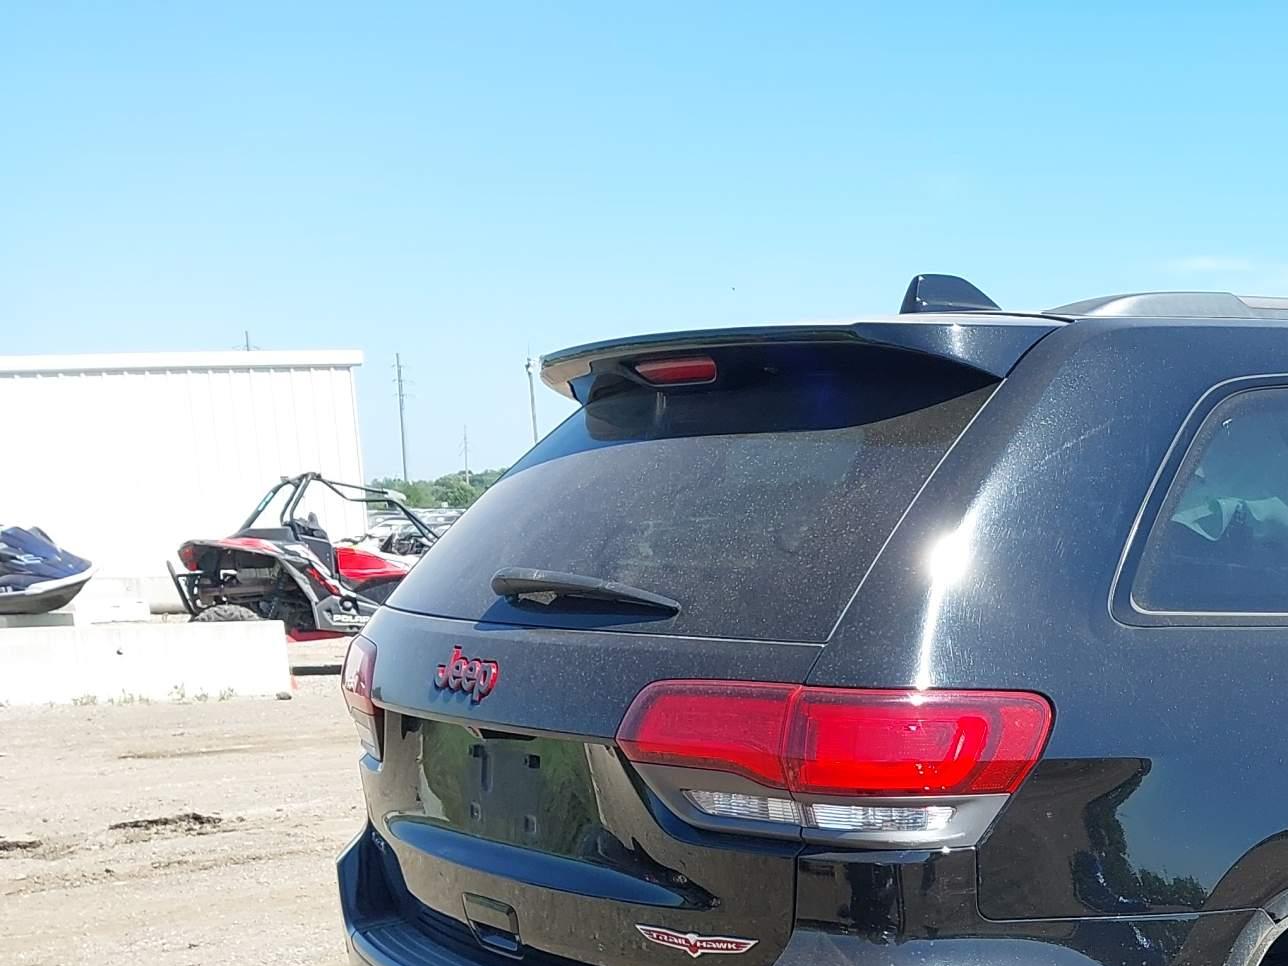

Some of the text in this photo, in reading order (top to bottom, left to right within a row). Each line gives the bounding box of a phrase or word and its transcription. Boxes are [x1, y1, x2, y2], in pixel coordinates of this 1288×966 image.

[433, 644, 499, 705] Jeep
[650, 932, 737, 950] TRAIL HAWK
